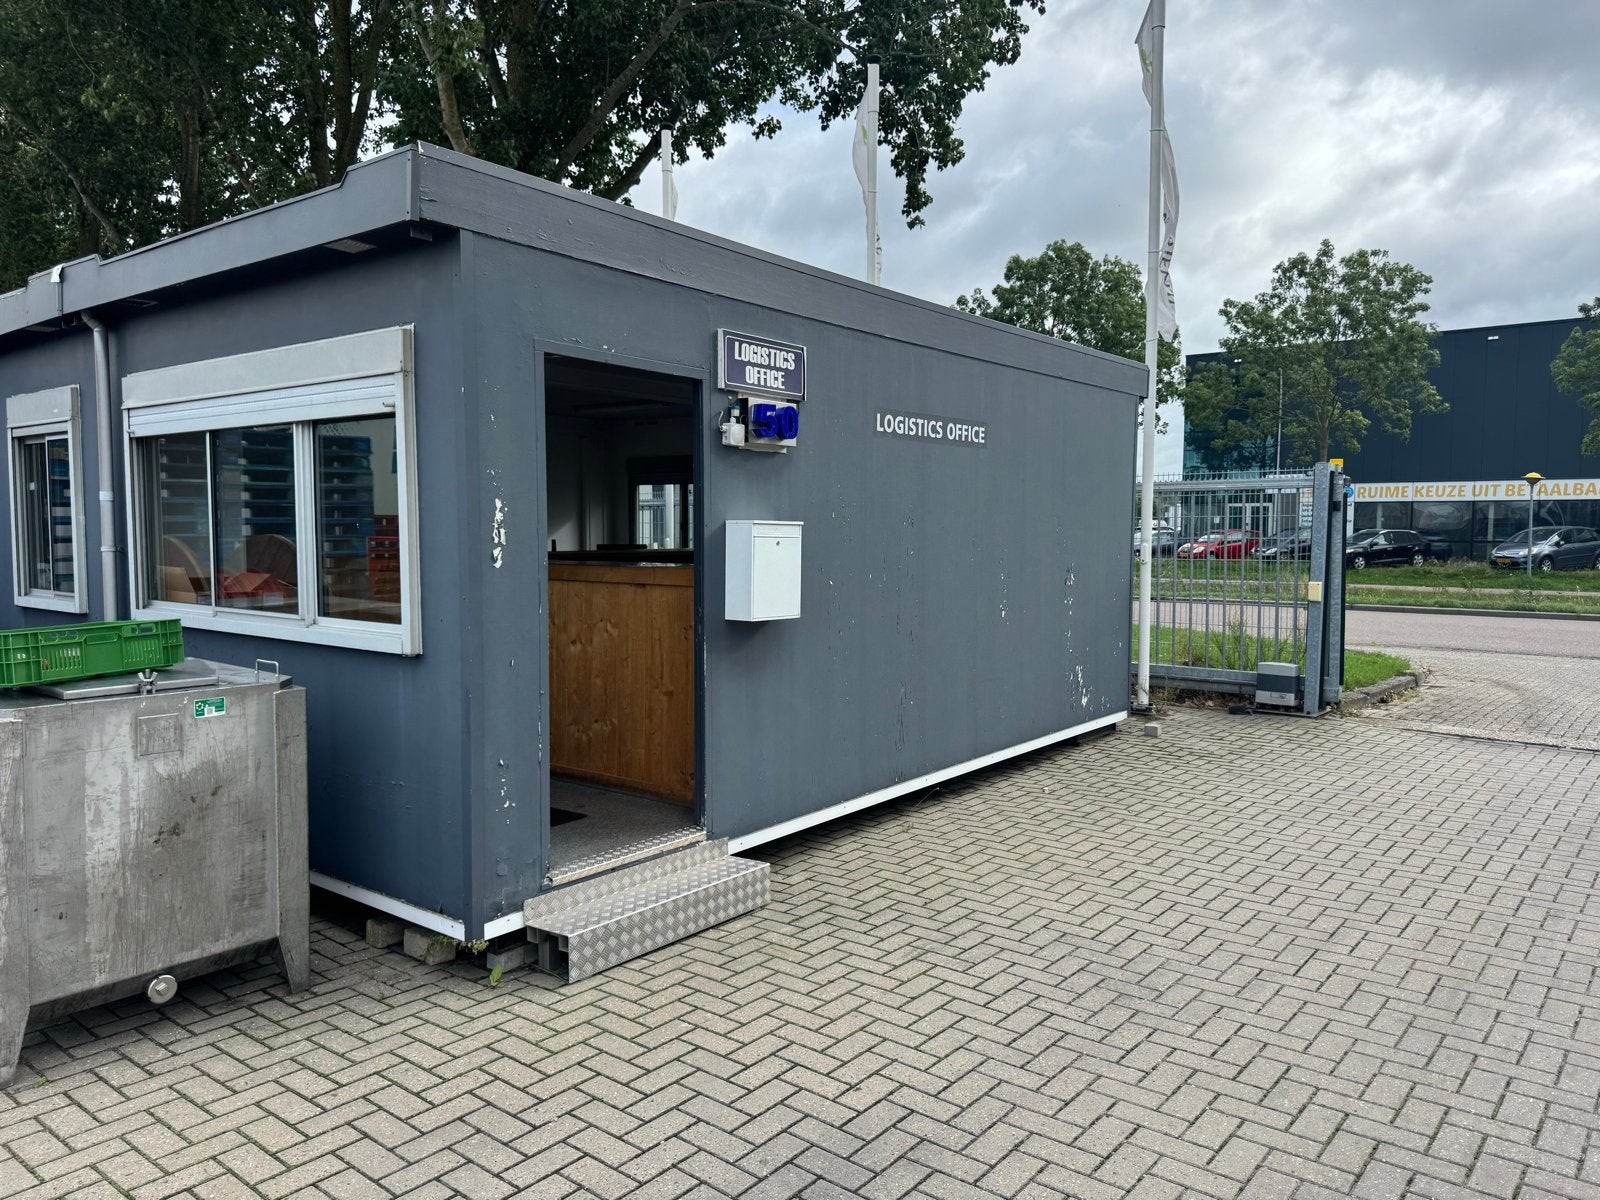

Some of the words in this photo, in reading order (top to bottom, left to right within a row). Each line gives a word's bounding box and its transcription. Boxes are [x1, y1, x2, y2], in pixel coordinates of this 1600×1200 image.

[734, 341, 795, 370] LOGISTICS
[745, 365, 785, 389] OFFICE
[751, 403, 799, 440] 50
[876, 413, 943, 439] LOGISTICS
[946, 422, 985, 443] OFFICE
[1357, 485, 1409, 499] RUIME
[1414, 484, 1466, 498] KEUZE
[1471, 484, 1501, 497] UIT
[1504, 482, 1600, 497] BEAALBA
